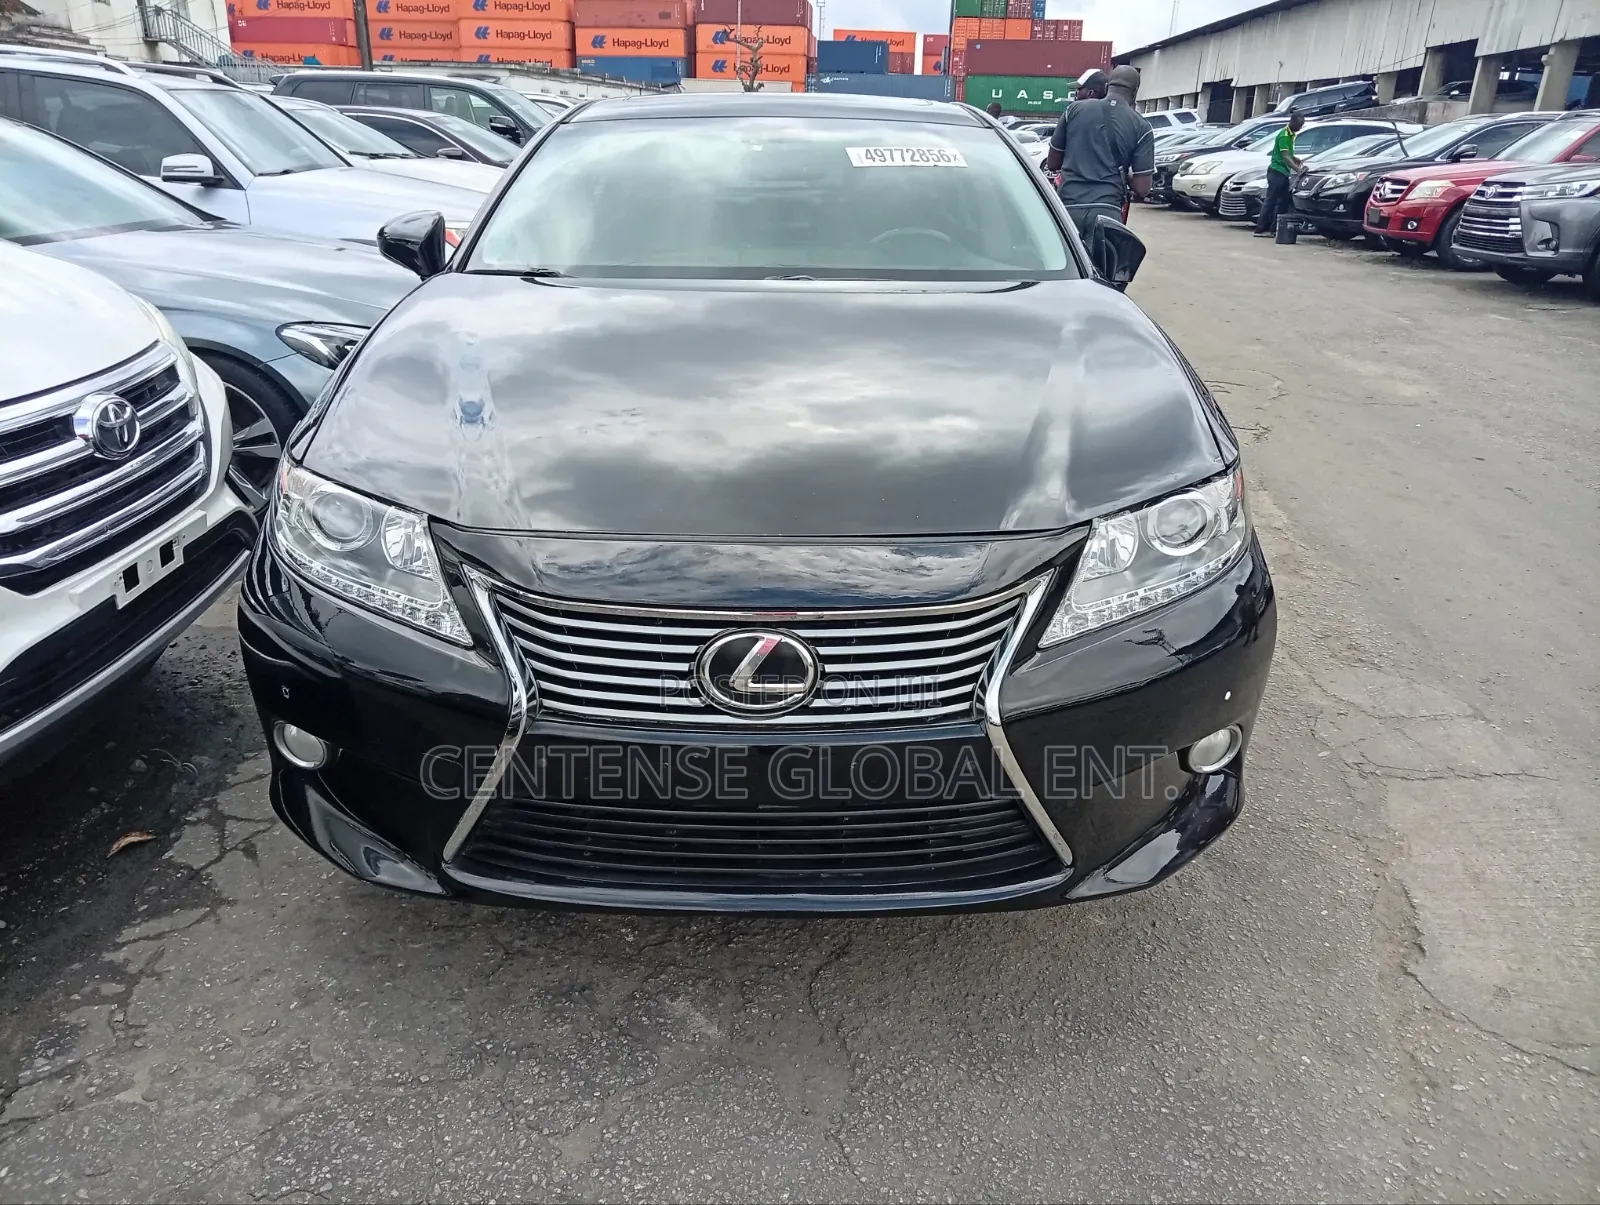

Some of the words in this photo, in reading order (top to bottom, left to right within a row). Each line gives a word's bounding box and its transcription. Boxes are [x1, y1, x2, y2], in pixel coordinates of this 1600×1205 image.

[276, 0, 331, 11] Hapag-Lloyd
[396, 3, 450, 14] Hapag-Lloyd
[494, 1, 551, 12] Hapag-Lloyd
[399, 30, 453, 41] Hapag-Lloyd
[496, 29, 552, 41] Hapag-Lloyd
[612, 38, 669, 49] Hapag-Lloyd
[261, 53, 316, 64] Hapag-Llo
[733, 62, 790, 75] pg-Lloyd
